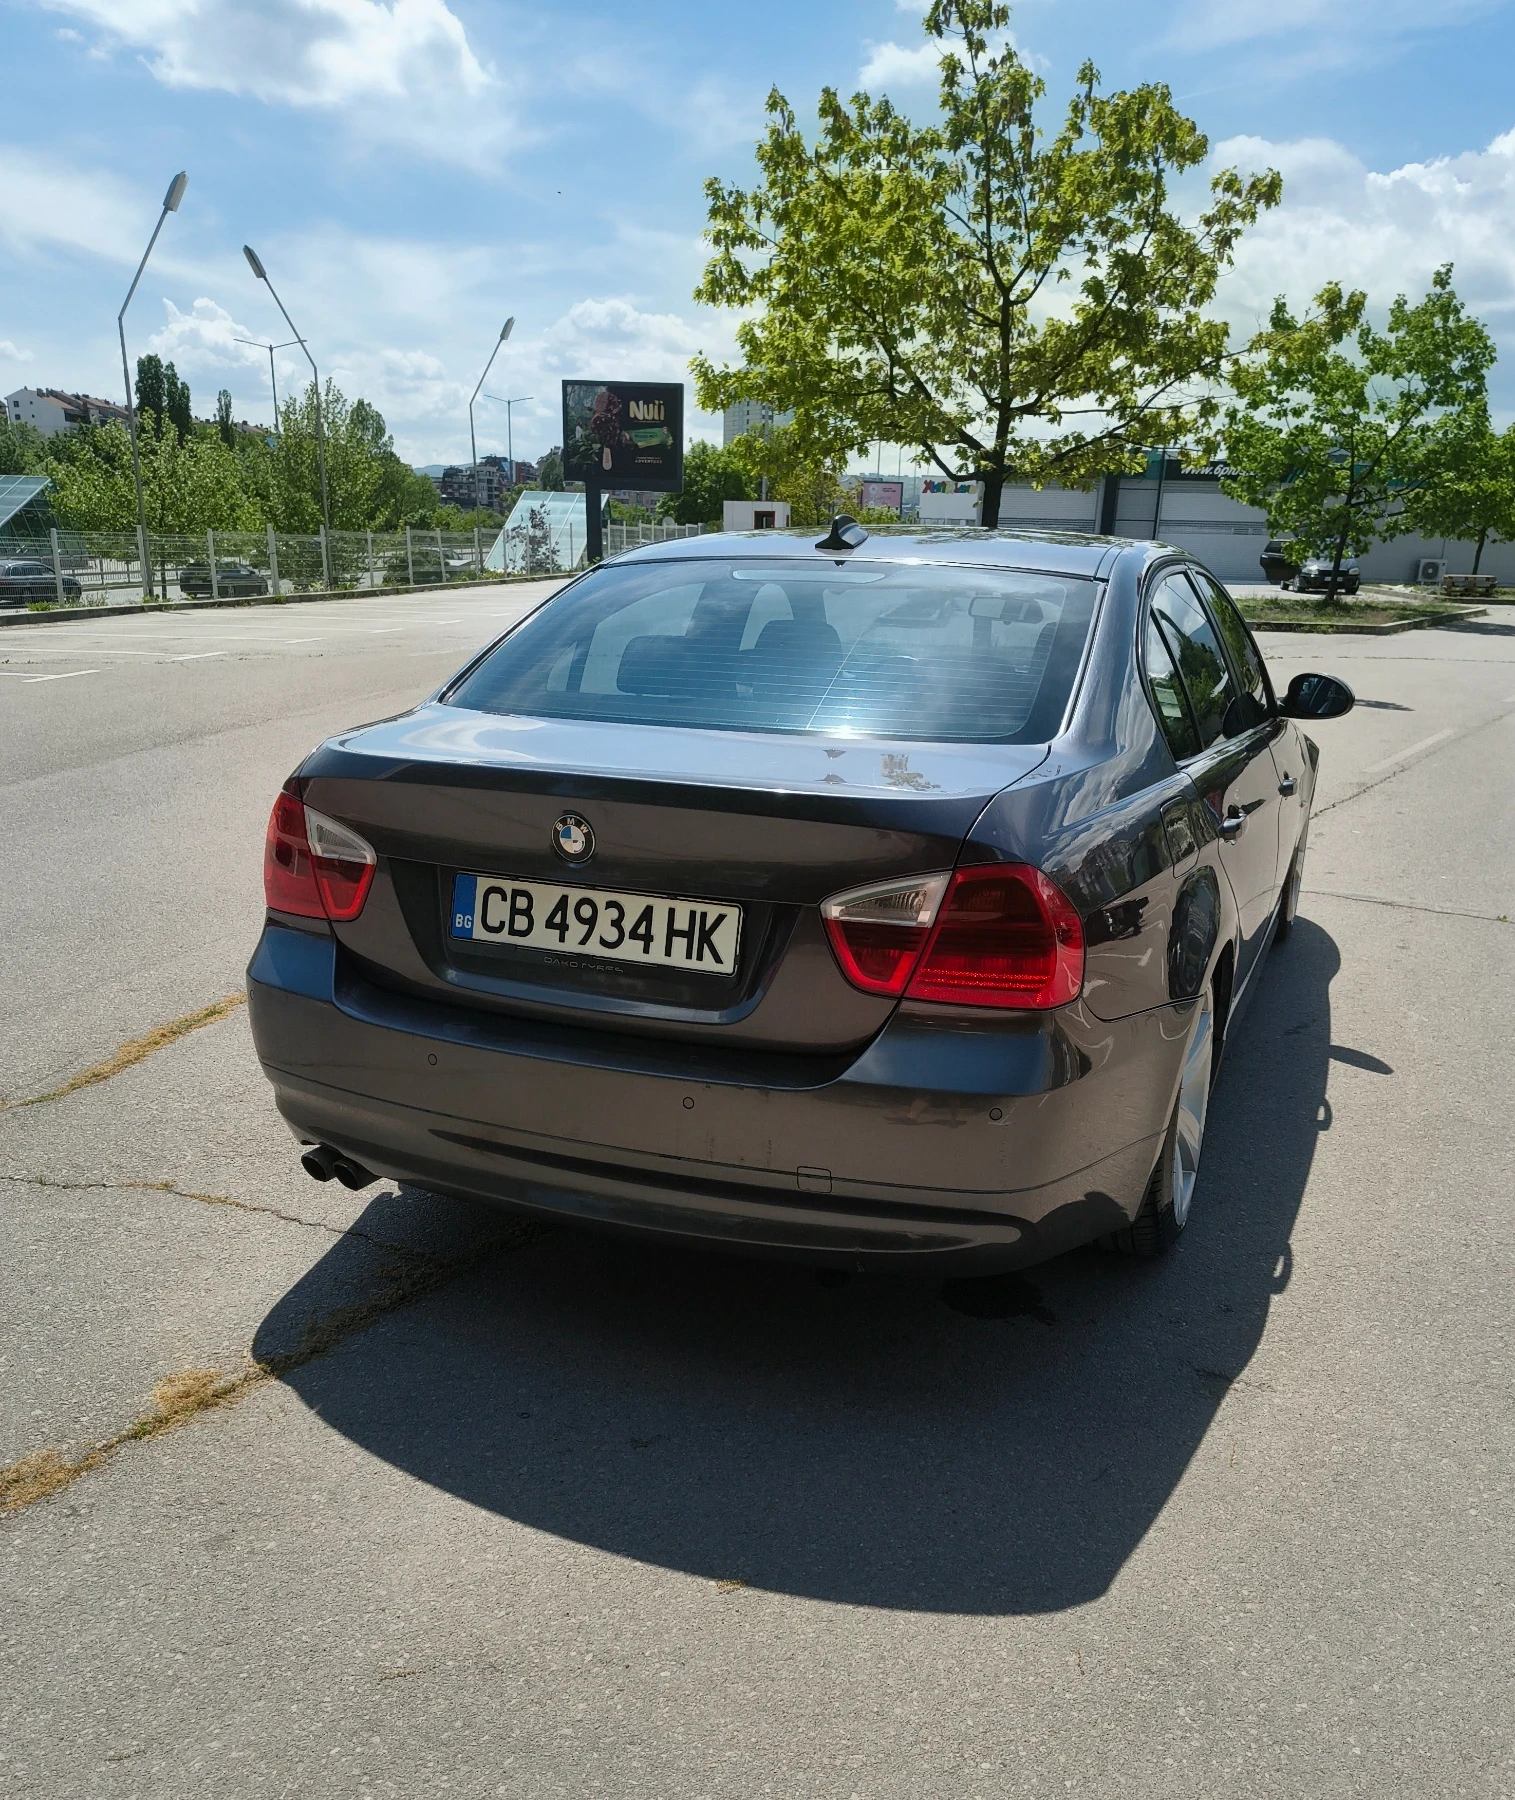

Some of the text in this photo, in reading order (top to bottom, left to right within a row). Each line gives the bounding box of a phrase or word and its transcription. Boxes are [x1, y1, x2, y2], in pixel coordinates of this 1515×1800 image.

[629, 399, 665, 420] Nuii
[555, 817, 589, 834] BMW
[455, 913, 472, 929] BG
[480, 886, 728, 965] CB 4934 HK
